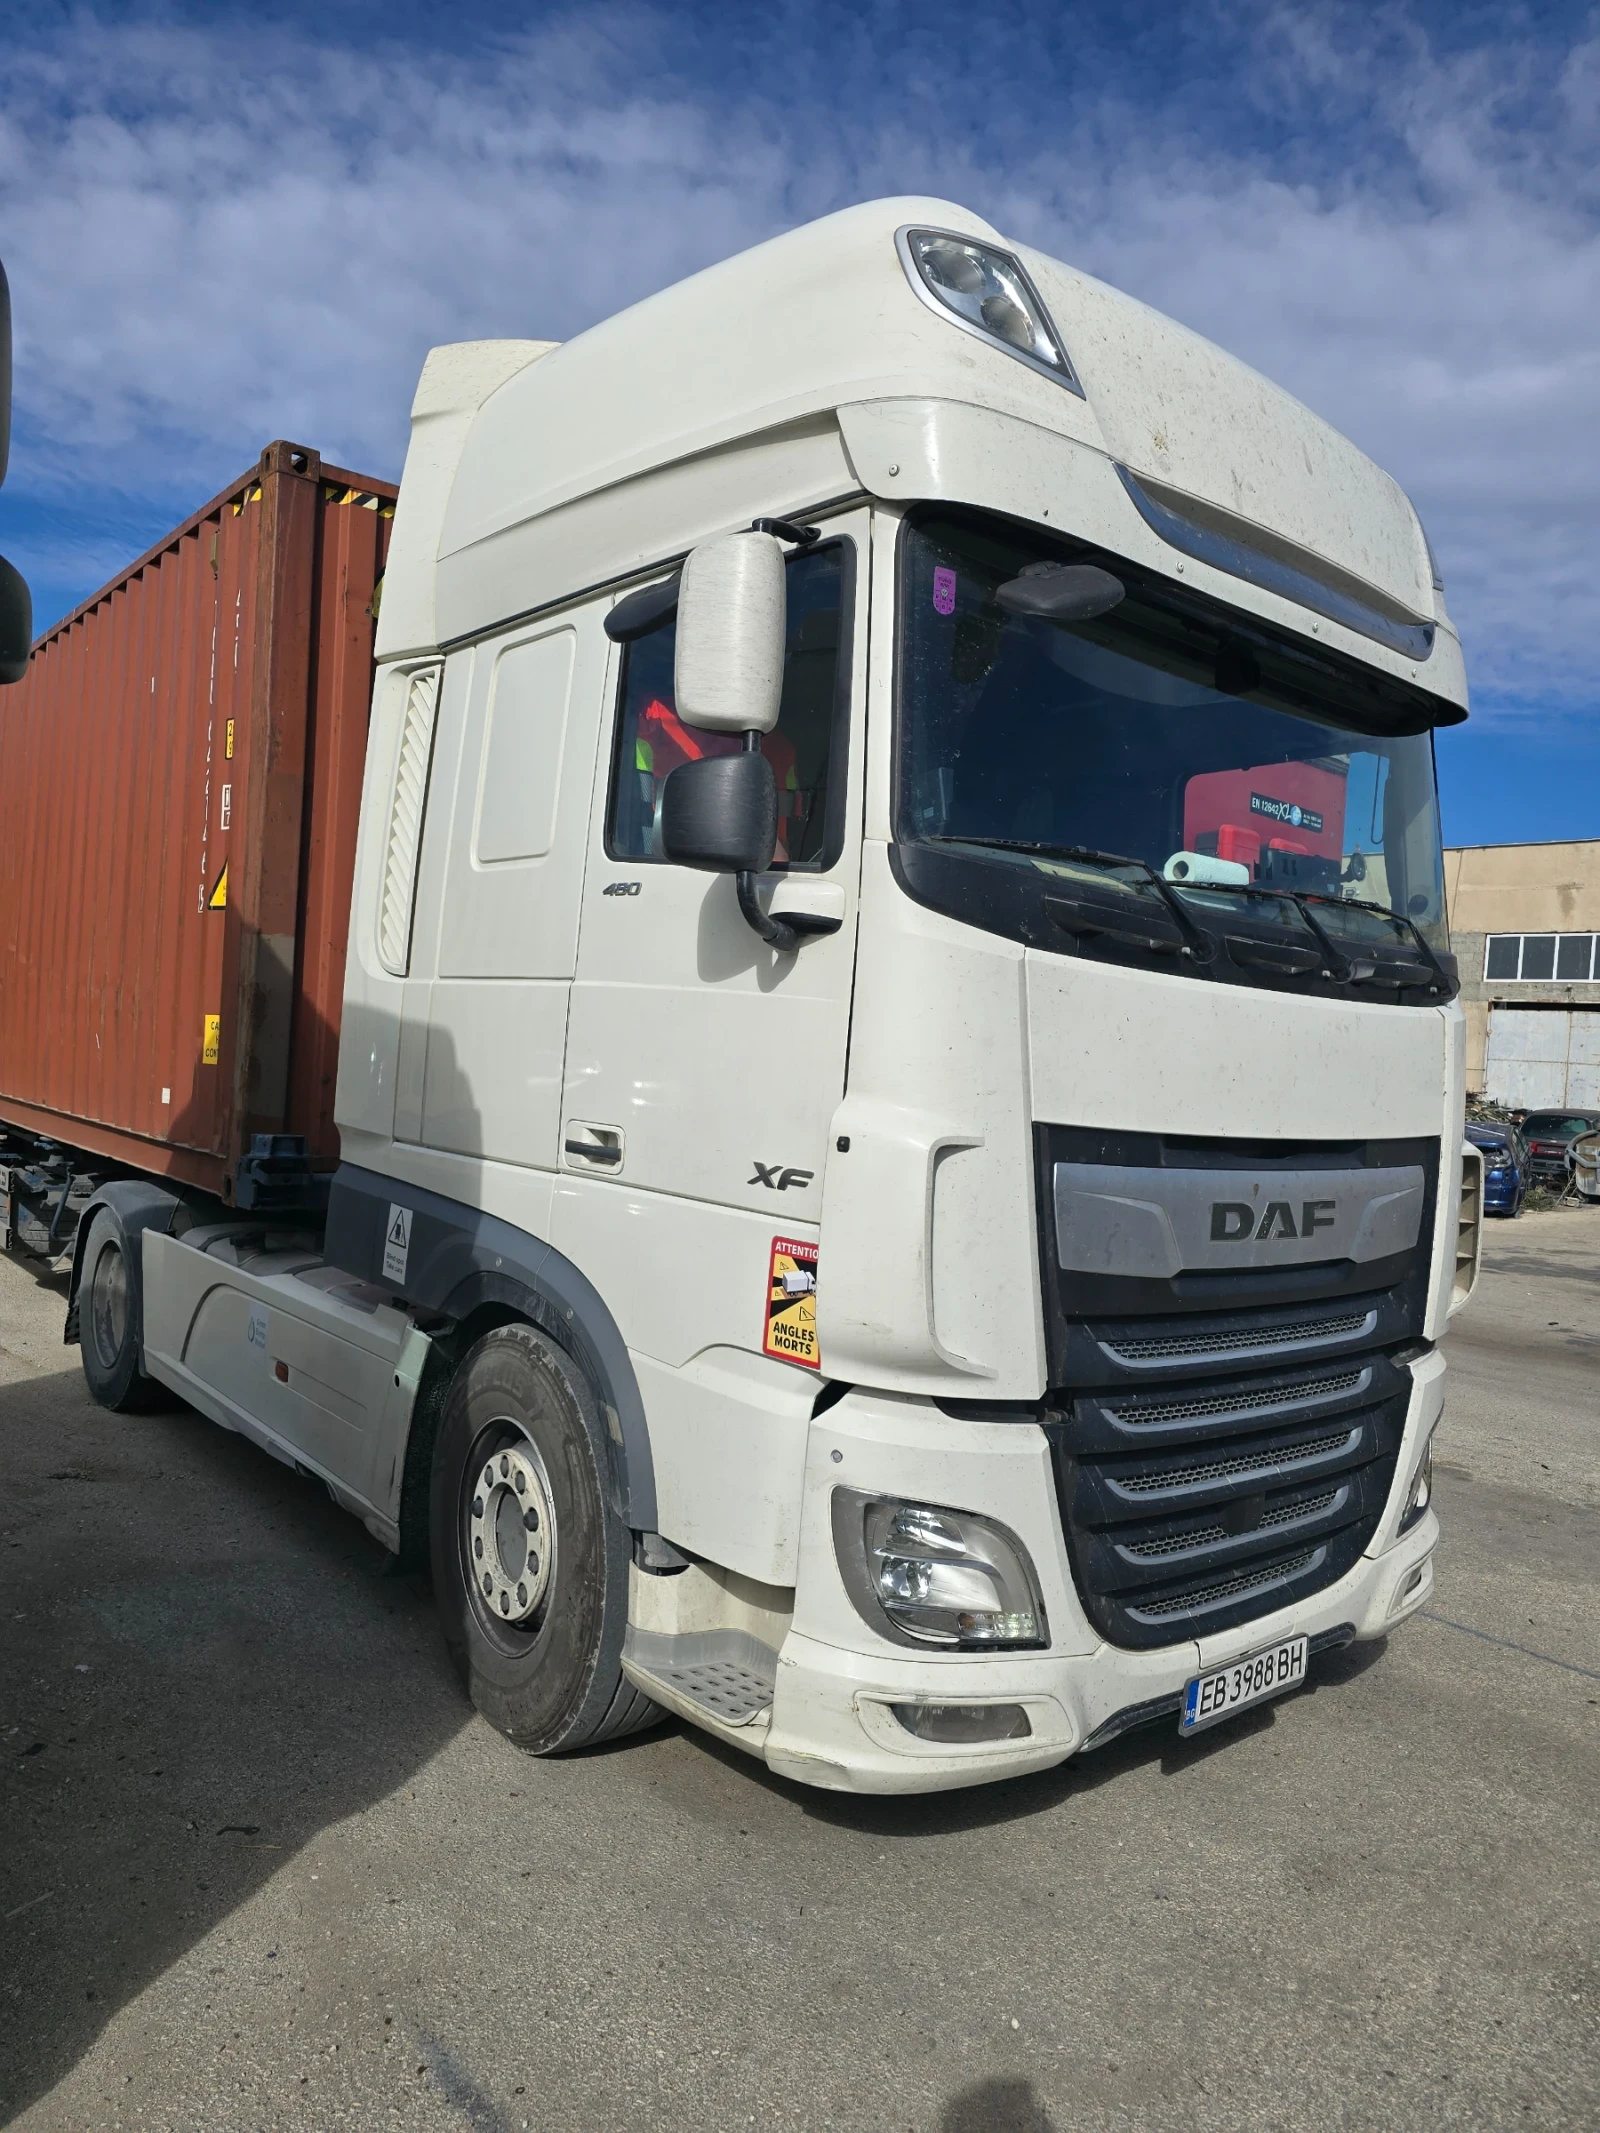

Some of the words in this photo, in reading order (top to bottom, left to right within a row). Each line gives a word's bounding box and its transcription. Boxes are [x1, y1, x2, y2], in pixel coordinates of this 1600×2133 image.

[1252, 797, 1260, 809] EN
[1261, 800, 1280, 815] 12642
[1276, 802, 1291, 821] XL
[602, 882, 643, 896] 480
[746, 1161, 815, 1191] XF
[1208, 1199, 1337, 1241] DAF
[775, 1241, 819, 1260] ATTENTIO
[773, 1321, 815, 1343] ANGLES
[774, 1335, 812, 1356] MORTS
[1199, 1675, 1227, 1716] EB
[1229, 1654, 1275, 1702] 3988
[1277, 1642, 1303, 1682] BH
[1186, 1708, 1195, 1720] BG
